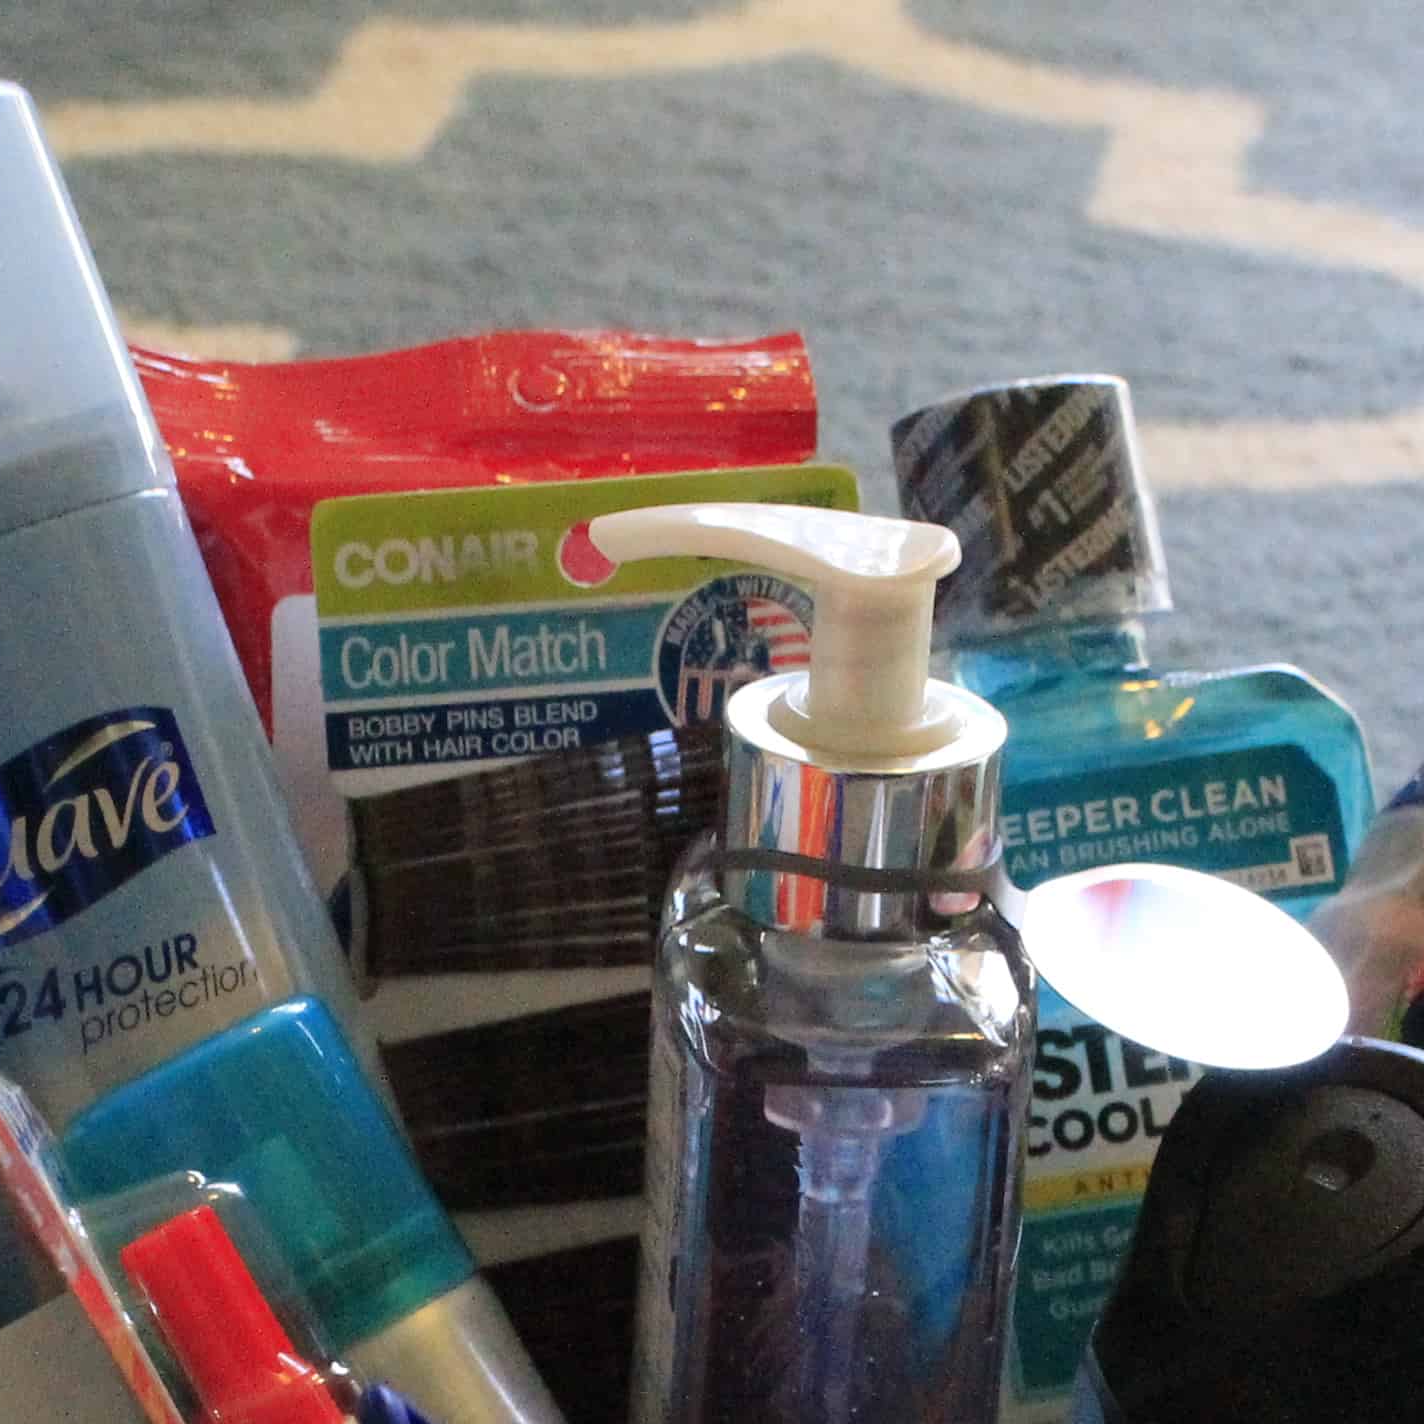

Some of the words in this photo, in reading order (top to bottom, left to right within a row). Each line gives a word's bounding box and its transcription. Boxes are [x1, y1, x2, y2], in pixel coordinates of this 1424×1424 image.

[334, 529, 541, 588] CONAIR
[340, 634, 456, 689] Color
[467, 620, 607, 680] Match
[348, 711, 436, 739] BOBBY
[447, 705, 504, 731] PINS
[514, 700, 598, 725] BLEND
[349, 737, 413, 765] WITH
[423, 734, 485, 758] HAIR
[492, 727, 580, 752] COLOR
[1000, 797, 1140, 846] EEPER
[1150, 775, 1287, 822] CLEAN
[1060, 826, 1200, 866] BRUSHING
[1208, 811, 1290, 842] ALONE
[75, 932, 200, 1012] HOUR
[79, 957, 259, 1055] protection
[1075, 1164, 1153, 1196] ANT
